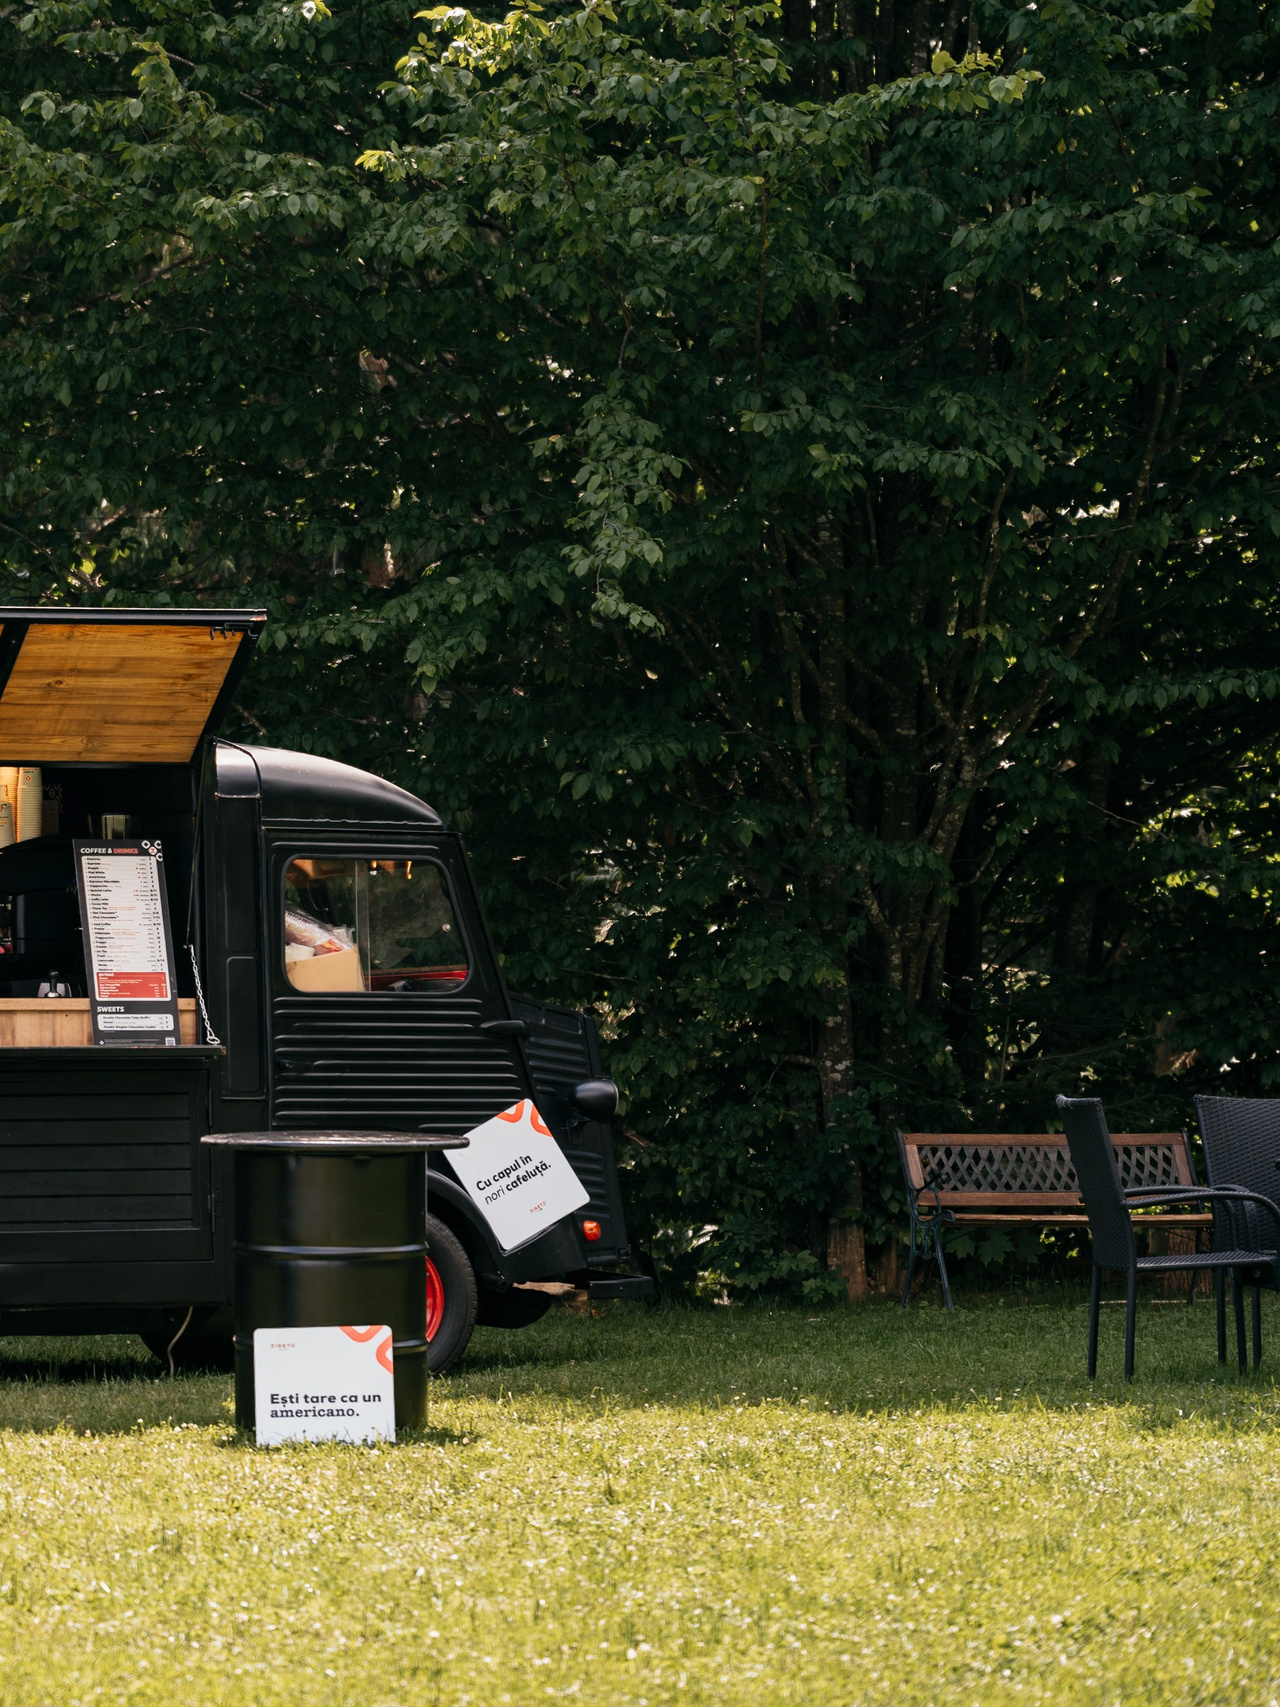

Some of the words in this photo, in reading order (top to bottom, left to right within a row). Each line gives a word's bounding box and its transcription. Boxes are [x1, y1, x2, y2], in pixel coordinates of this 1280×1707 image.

[476, 1179, 492, 1191] Cu
[493, 1159, 521, 1182] capul
[519, 1155, 532, 1165] în
[485, 1185, 505, 1204] nori
[506, 1160, 551, 1191] cafeluță.
[270, 1393, 299, 1408] Ești
[303, 1394, 337, 1404] tare
[340, 1394, 358, 1403] ca
[362, 1394, 381, 1403] un
[270, 1406, 360, 1418] americano.
